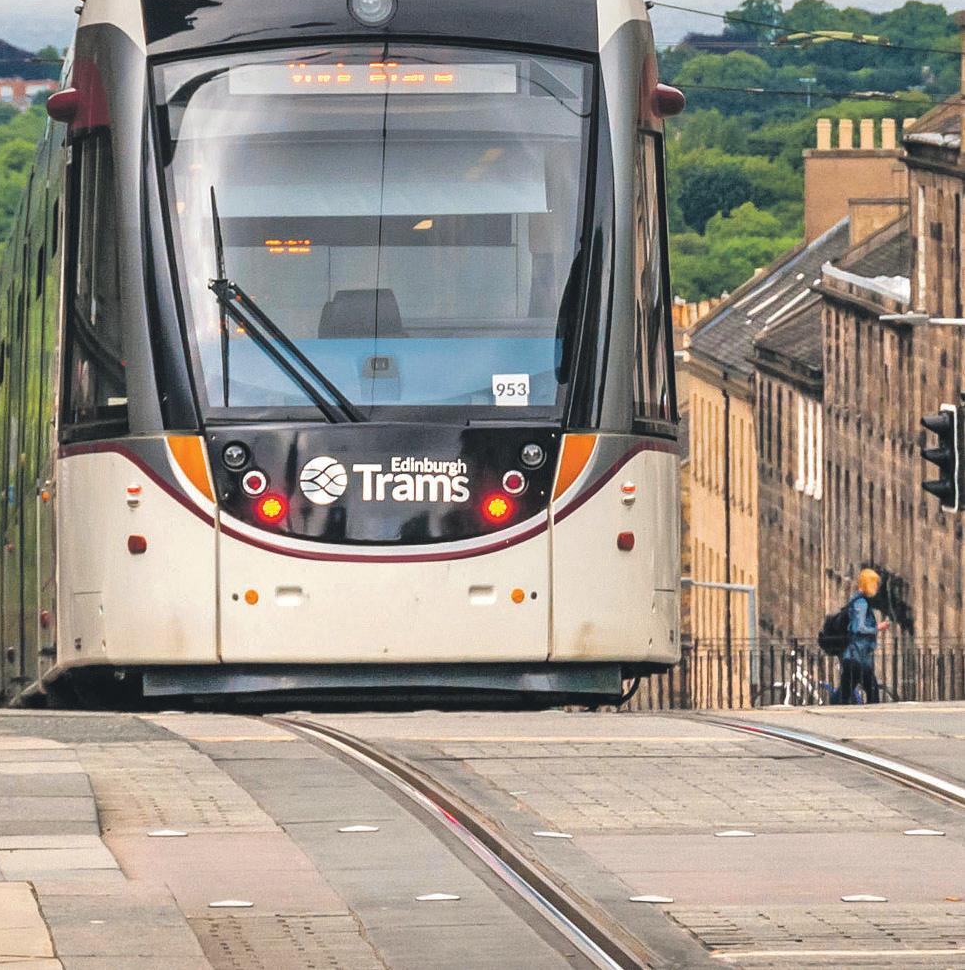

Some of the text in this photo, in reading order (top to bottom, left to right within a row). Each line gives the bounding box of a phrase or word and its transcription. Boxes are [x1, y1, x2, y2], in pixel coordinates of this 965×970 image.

[495, 381, 527, 397] 953
[391, 456, 467, 476] Edinburgh
[353, 463, 470, 503] Trams
